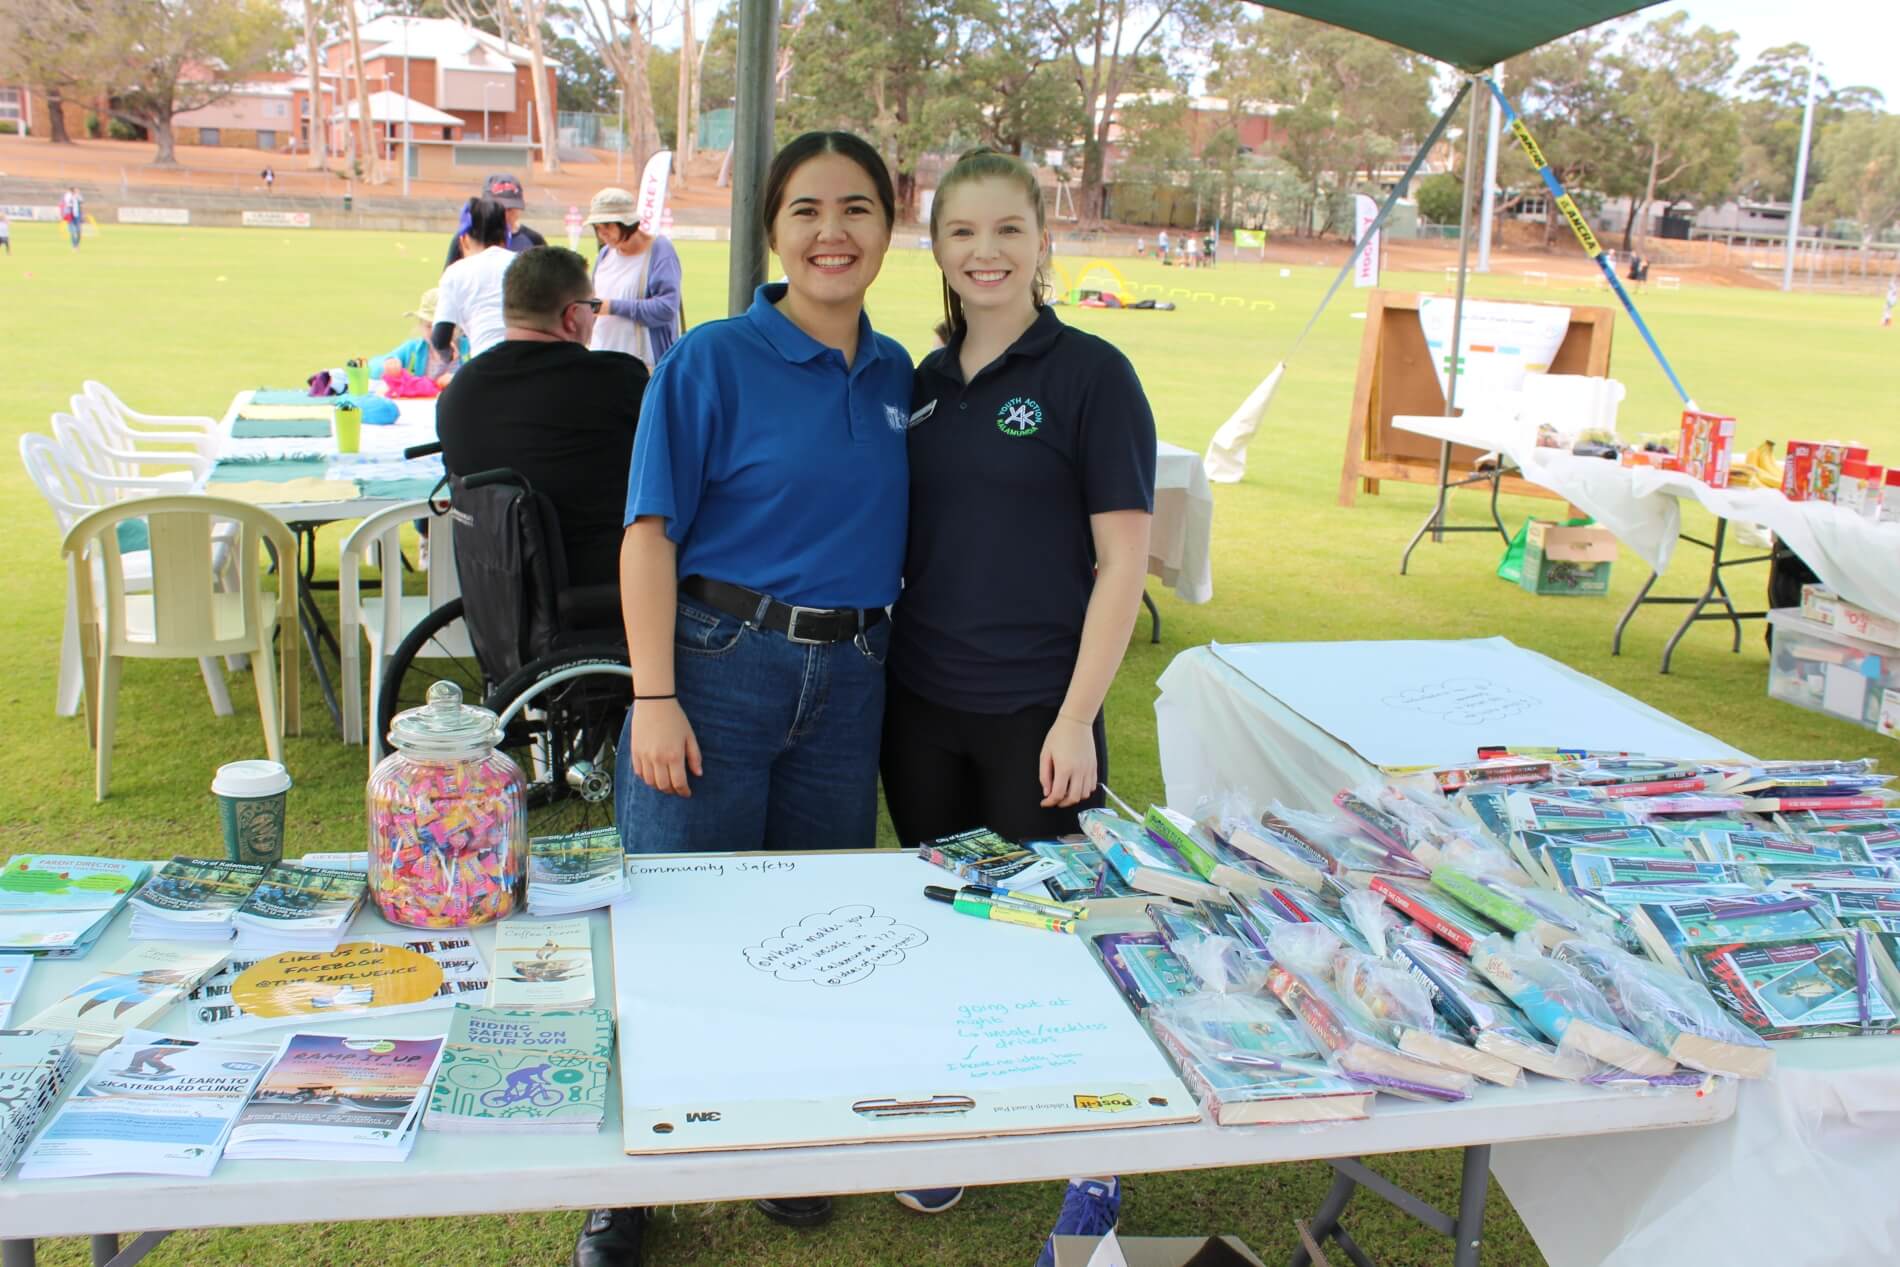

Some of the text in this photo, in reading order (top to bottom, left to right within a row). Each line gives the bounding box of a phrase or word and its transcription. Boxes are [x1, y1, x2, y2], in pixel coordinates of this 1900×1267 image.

[640, 174, 659, 231] OCKEY
[998, 396, 1043, 423] YOUTH ACTION
[191, 858, 210, 867] City
[219, 861, 265, 871] Kalamunda
[629, 859, 797, 876] Community Safety
[322, 868, 367, 878] Kalamunda
[278, 953, 322, 965] LIKE
[331, 948, 354, 960] US
[283, 957, 386, 975] FACEBOOK
[316, 965, 418, 983] INFLUENCE
[468, 1019, 531, 1032] RIDING
[468, 1027, 567, 1039] SAFELY ON
[467, 1035, 568, 1046] YOUR OWN
[293, 1051, 424, 1063] RAMP IT UP
[100, 1079, 247, 1093] SKATEBOARD CLINIC
[179, 1076, 250, 1086] LEARN TO
[1079, 1098, 1133, 1110] Post-it
[685, 1111, 723, 1123] 3M
